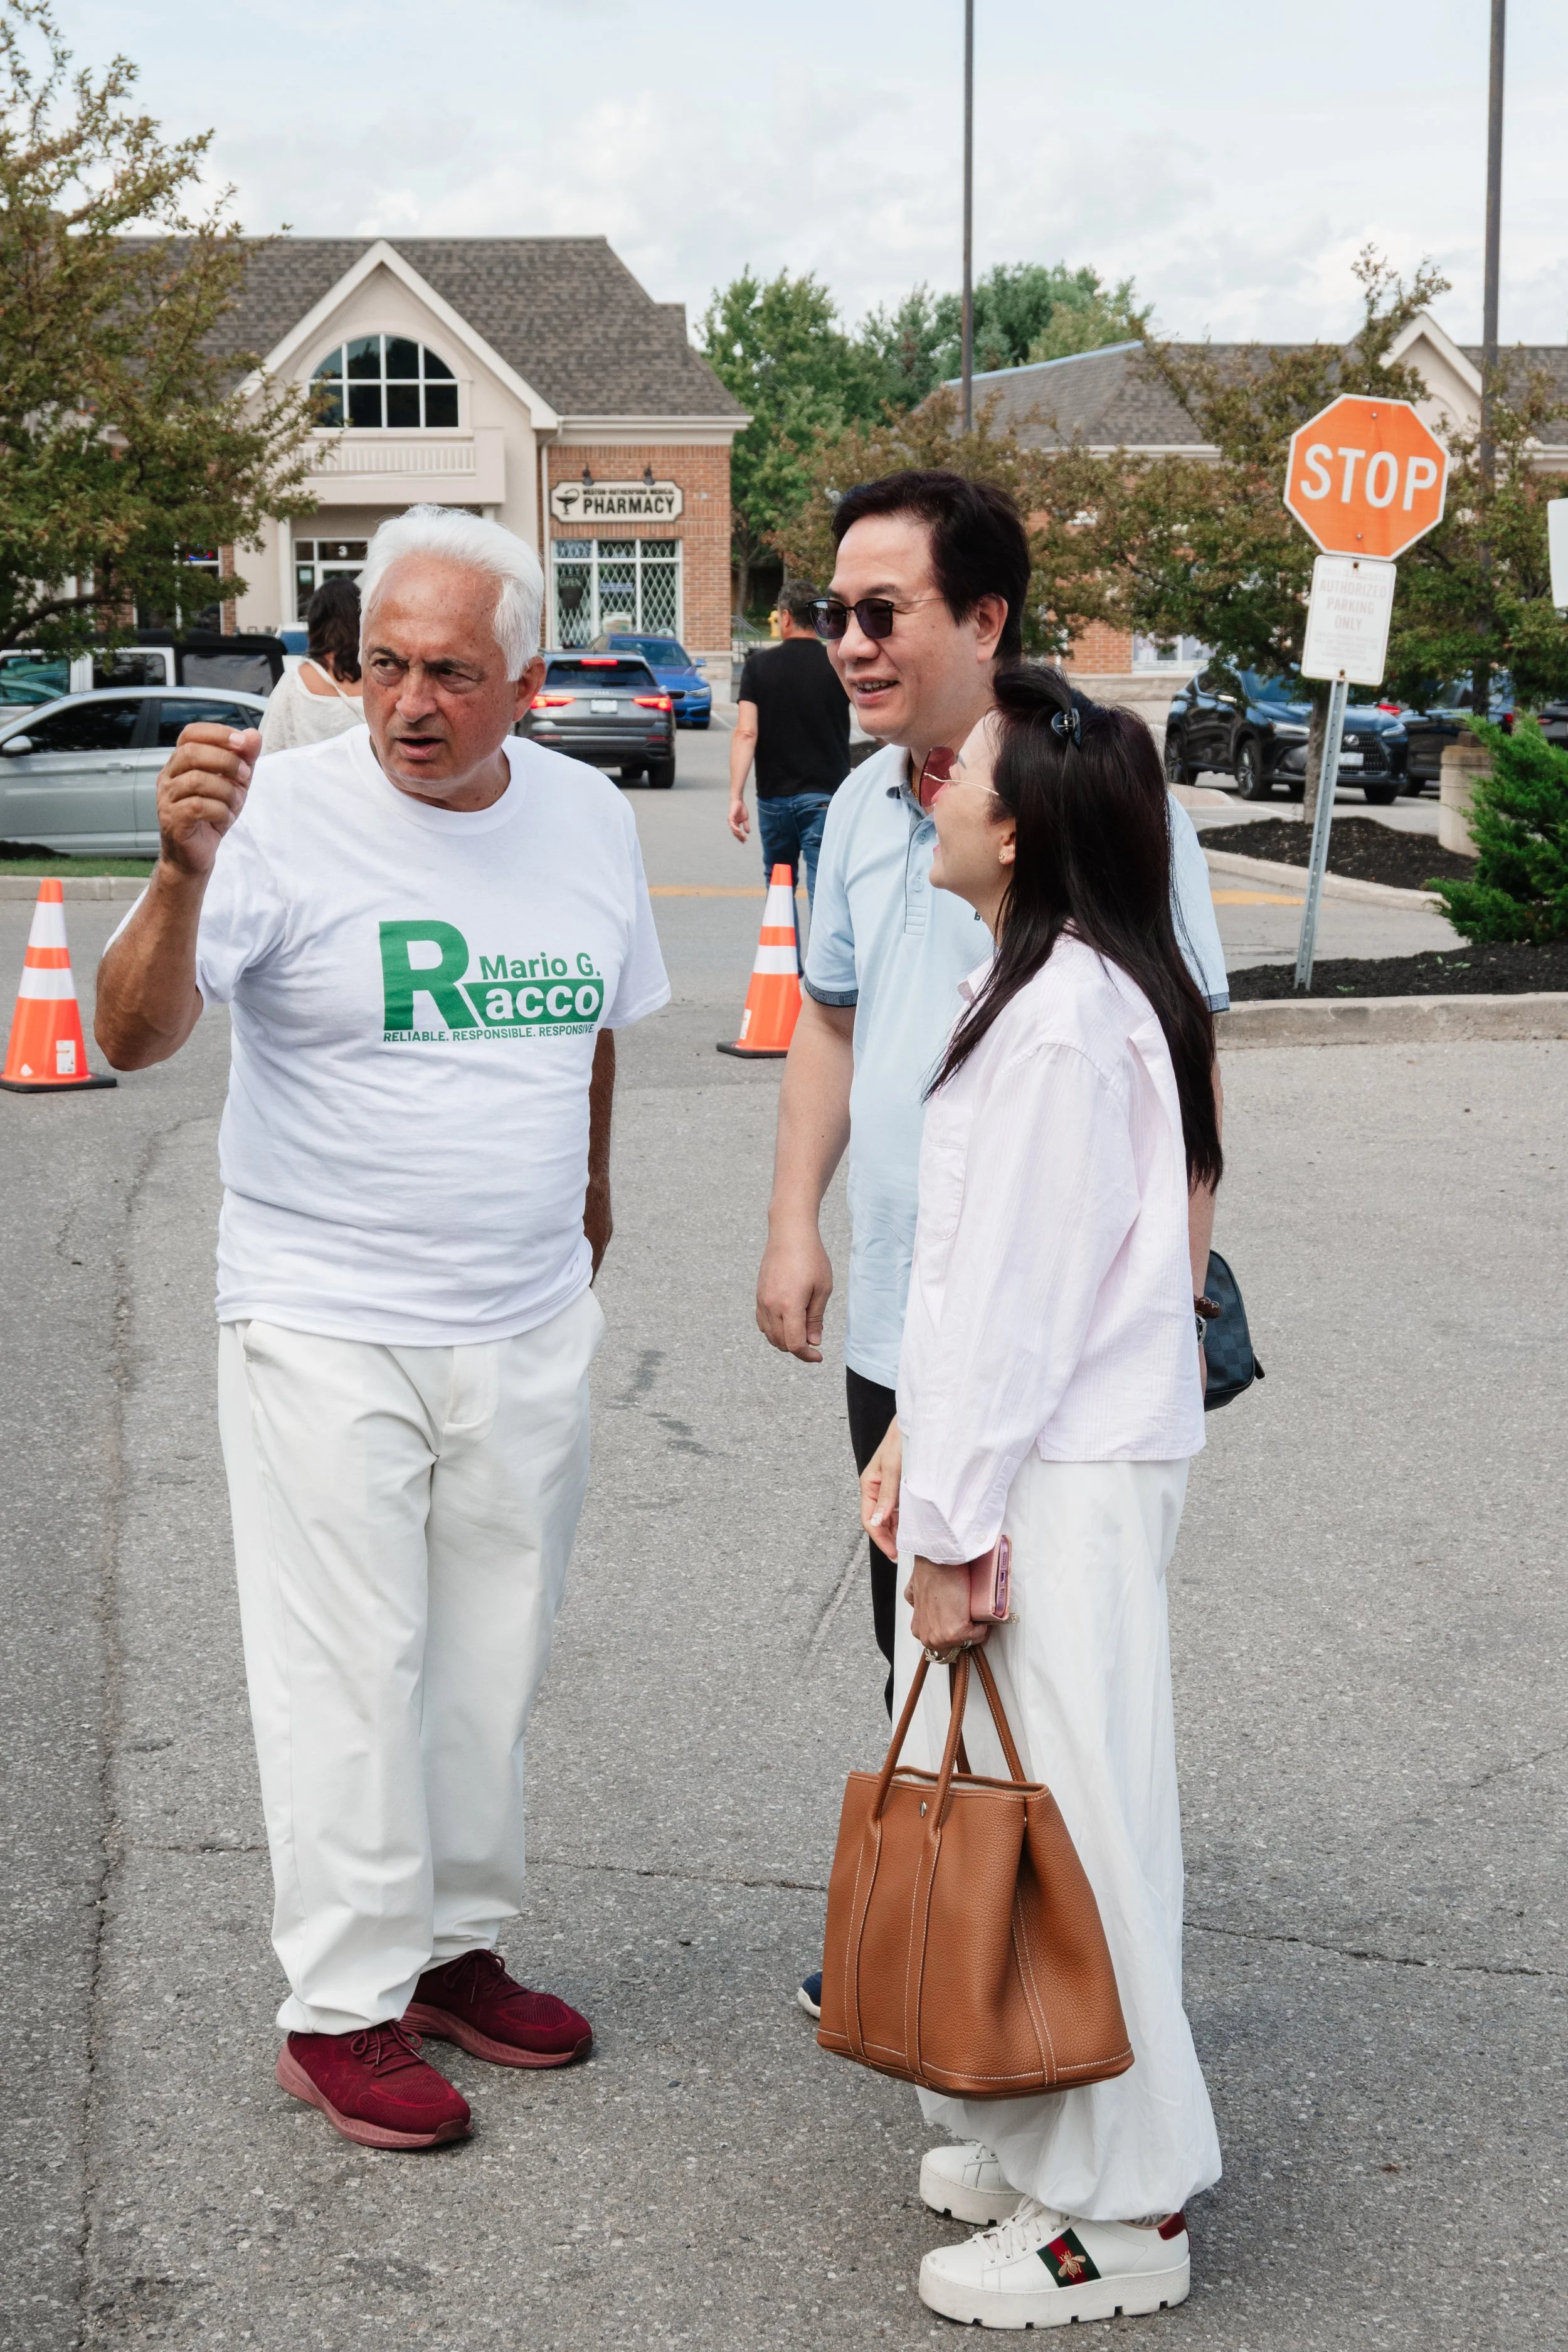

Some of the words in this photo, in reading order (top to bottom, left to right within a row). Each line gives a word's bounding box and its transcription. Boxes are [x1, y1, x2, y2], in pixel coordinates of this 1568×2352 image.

[1300, 443, 1438, 511] STOP
[583, 496, 674, 514] PHARMACY
[339, 545, 347, 557] 3
[1319, 578, 1387, 599] AUTHORIZED
[1327, 596, 1375, 615] PARKING
[1335, 615, 1363, 630] ONLY
[479, 951, 568, 980] Mario
[576, 952, 601, 977] G.
[383, 1030, 449, 1042] RELIABLE.
[453, 1027, 536, 1041] RESPONSIBLE.
[539, 1024, 595, 1037] RESPONSIVE.
